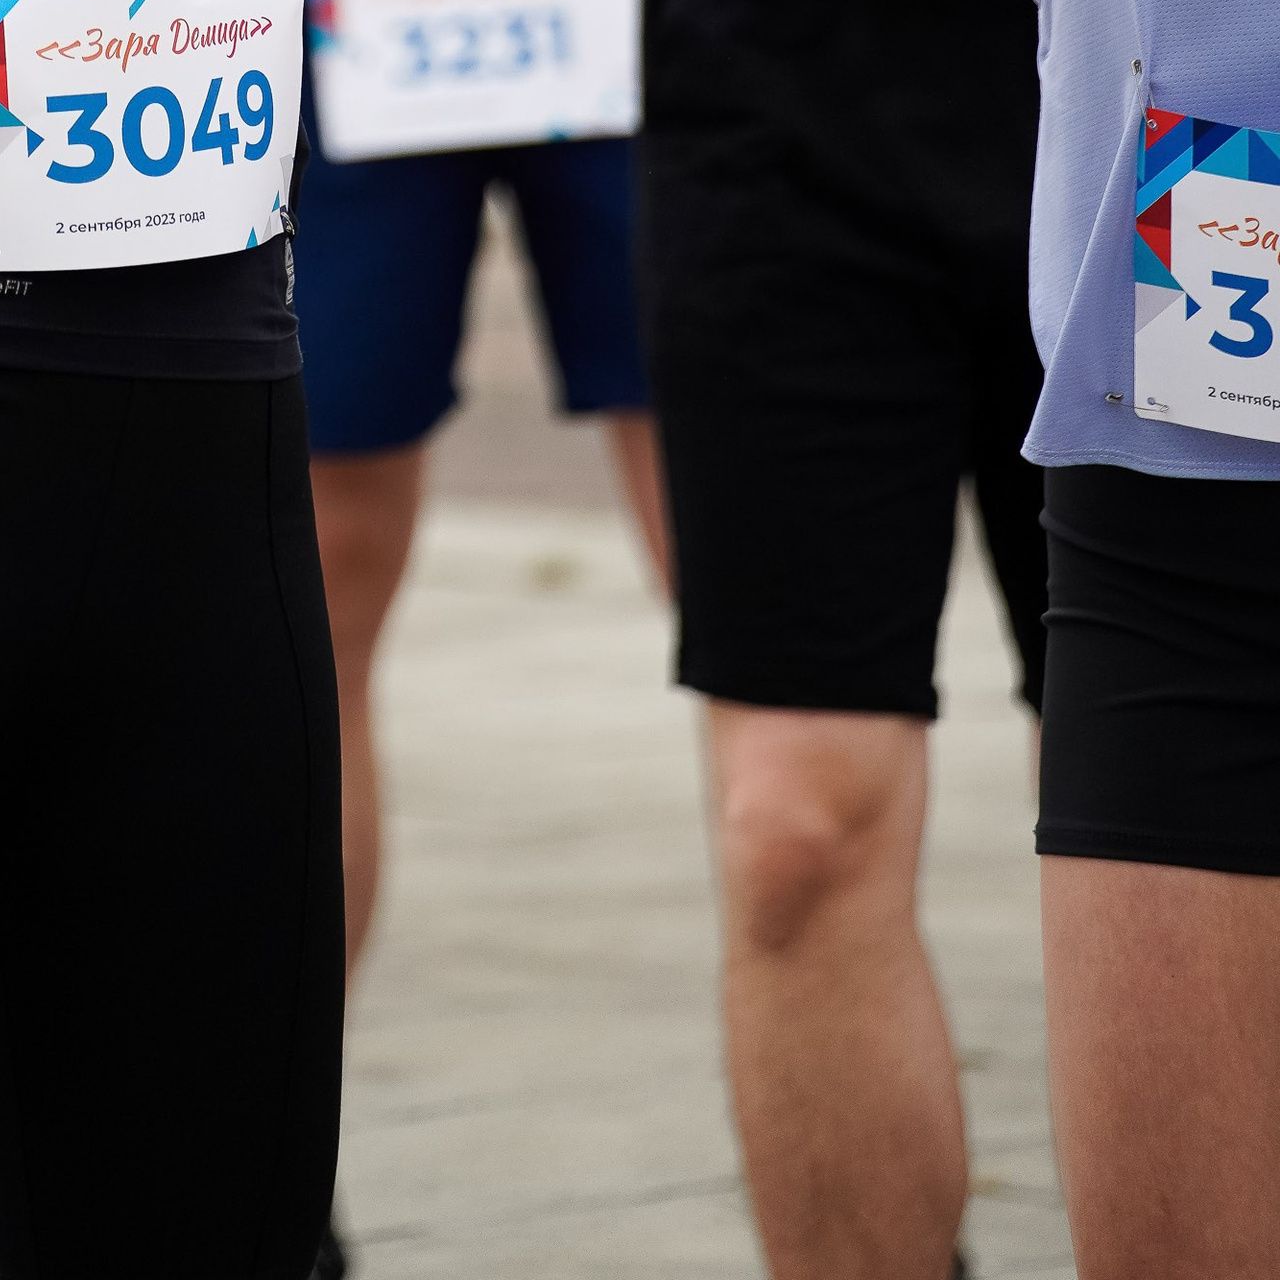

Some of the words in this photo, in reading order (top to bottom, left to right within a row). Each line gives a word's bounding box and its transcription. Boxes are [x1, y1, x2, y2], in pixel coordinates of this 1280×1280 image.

[46, 69, 275, 185] 3049
[55, 222, 66, 234] 2
[69, 217, 142, 233] сентября
[144, 212, 177, 227] 2023
[179, 210, 206, 224] года
[1208, 386, 1217, 398] 2
